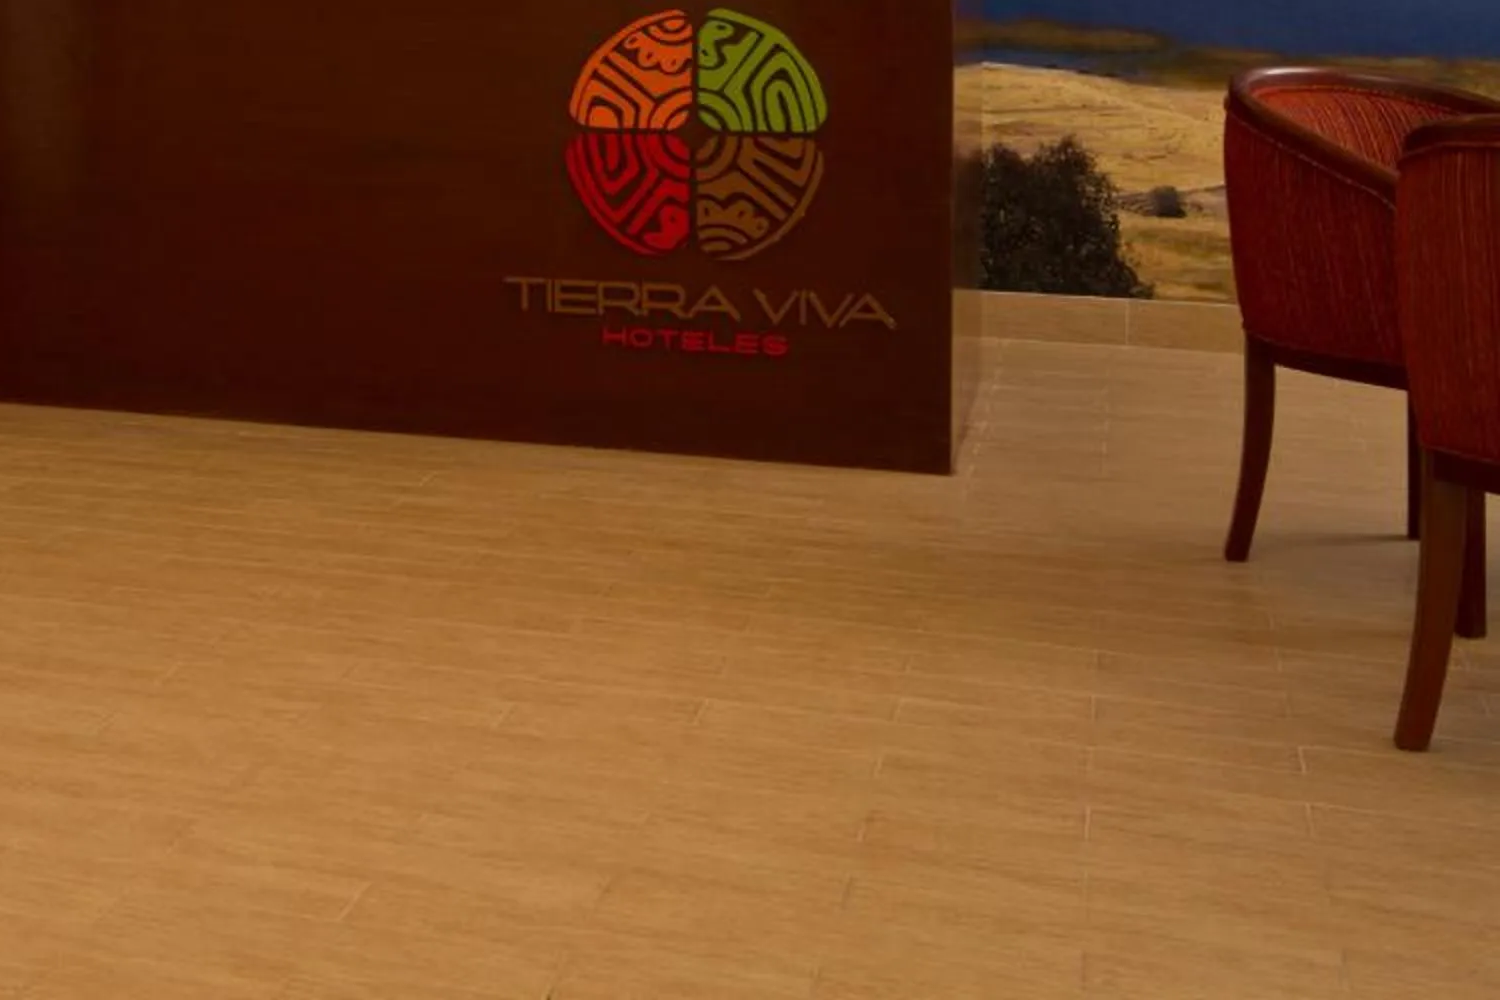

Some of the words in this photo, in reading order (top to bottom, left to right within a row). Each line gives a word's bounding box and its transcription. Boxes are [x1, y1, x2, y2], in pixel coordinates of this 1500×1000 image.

[504, 276, 741, 319] TIERRA
[754, 291, 897, 330] VIVA
[602, 327, 789, 355] HOTELES
